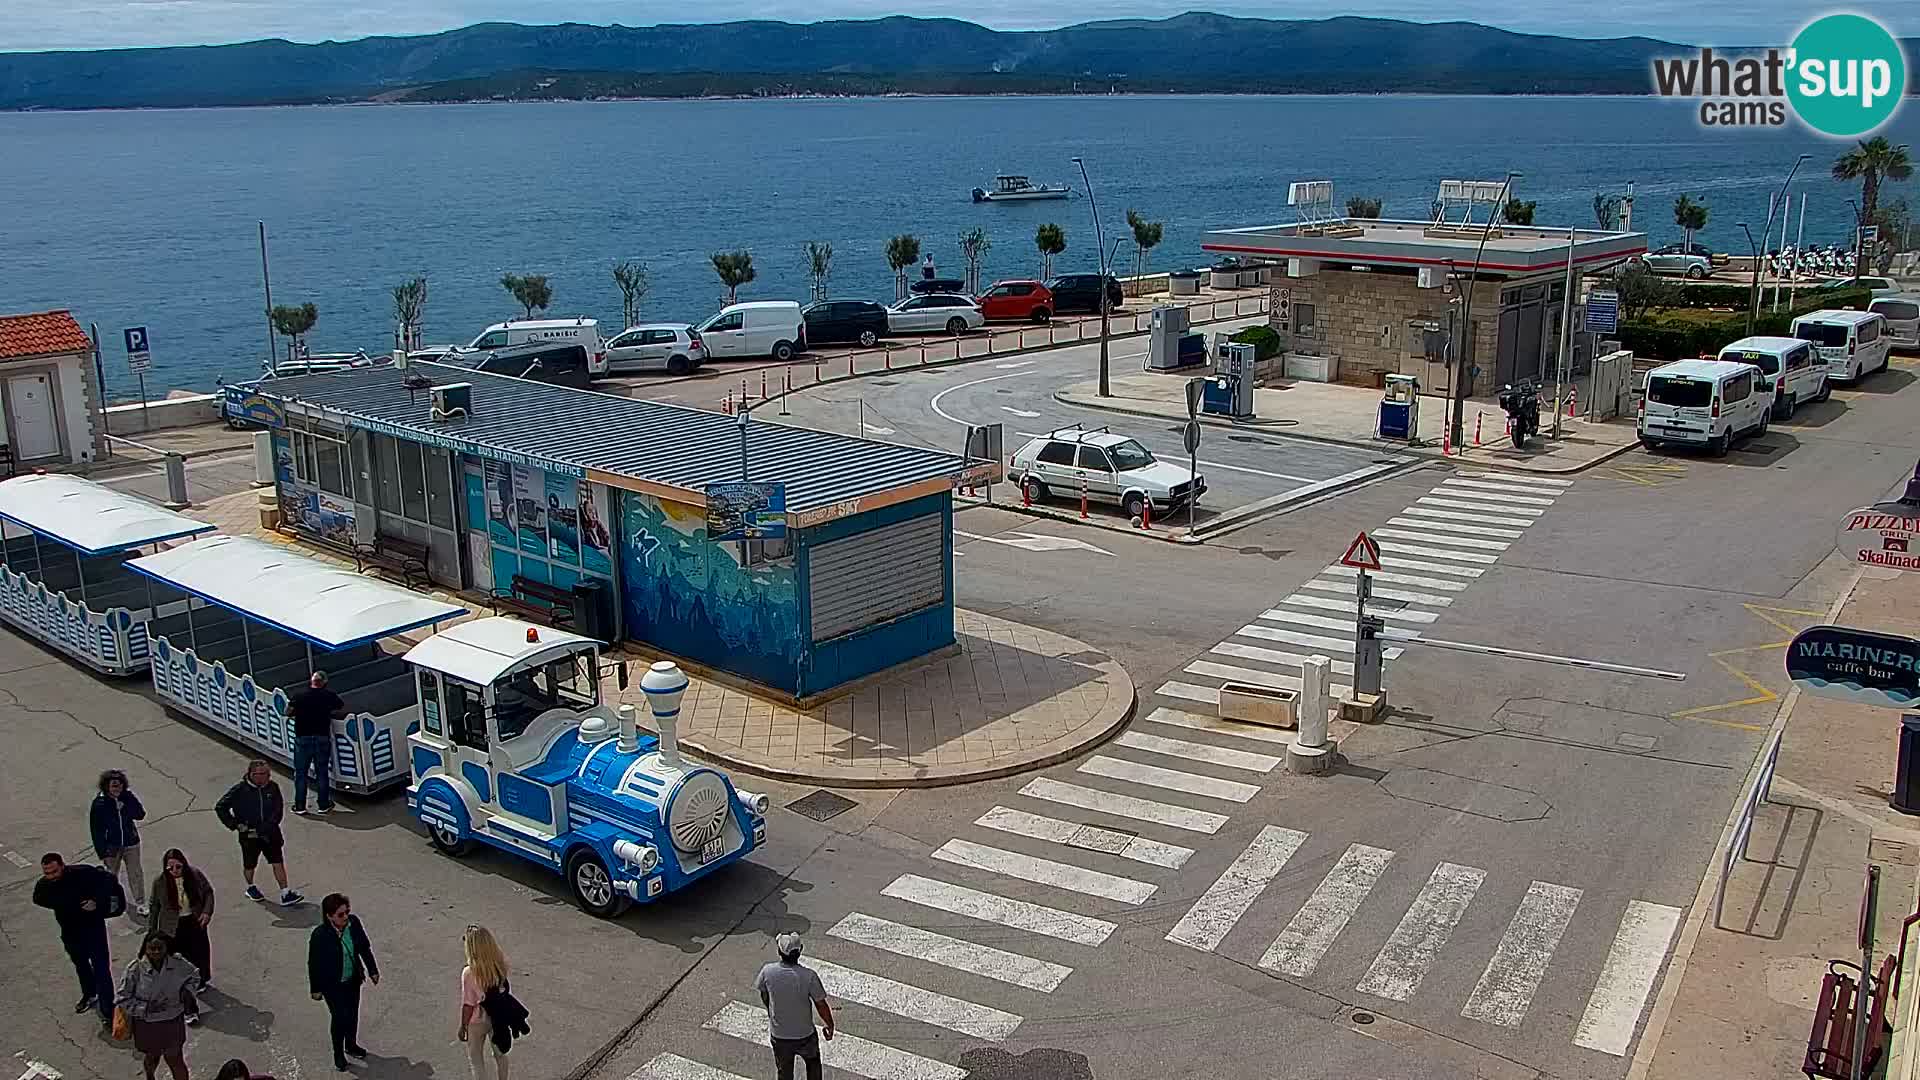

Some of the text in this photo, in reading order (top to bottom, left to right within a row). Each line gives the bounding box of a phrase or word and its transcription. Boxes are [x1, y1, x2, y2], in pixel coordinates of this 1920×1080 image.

[129, 331, 142, 349] P
[1742, 351, 1760, 360] TAXI
[395, 428, 435, 444] AUTOBUSNA
[436, 437, 467, 451] POSTAJA
[477, 446, 493, 457] BUS
[493, 450, 526, 465] STATION
[527, 457, 554, 471] TICKET
[555, 463, 582, 477] OFFICE
[1879, 529, 1915, 541] GRILL
[1826, 662, 1895, 680] caffe bar
